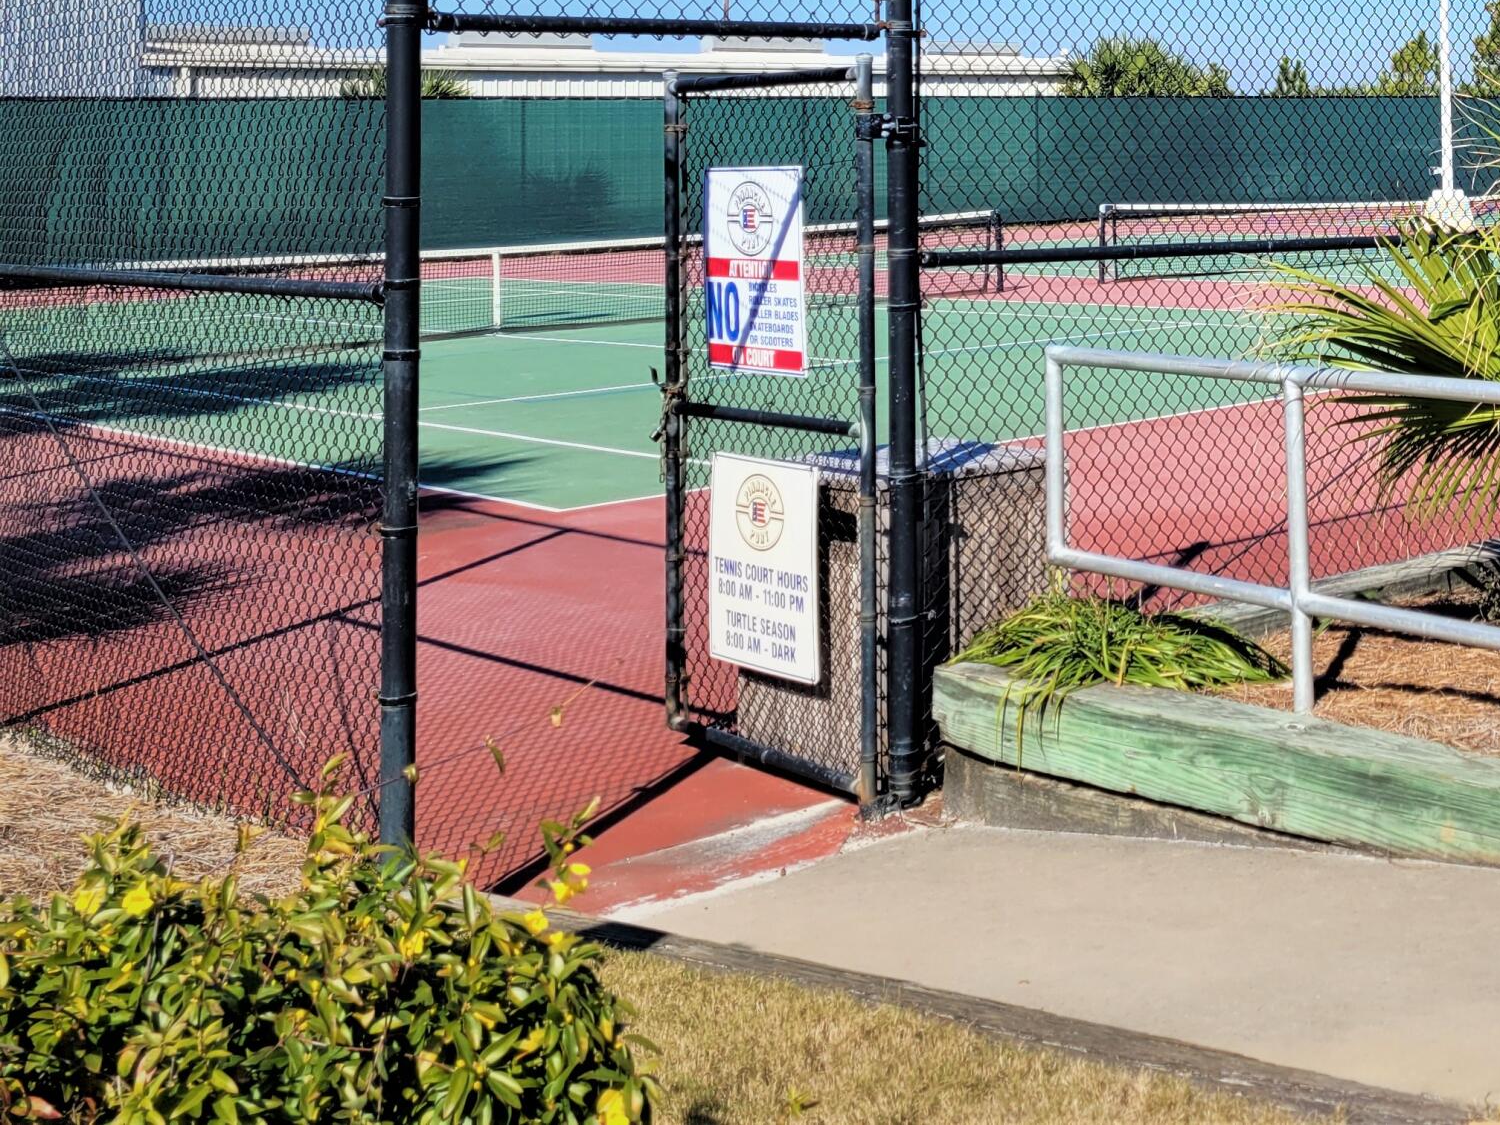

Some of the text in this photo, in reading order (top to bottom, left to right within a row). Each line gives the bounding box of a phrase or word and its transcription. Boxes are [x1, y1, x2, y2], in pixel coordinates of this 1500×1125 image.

[729, 259, 775, 279] ATTENTION
[707, 281, 740, 342] NO
[774, 297, 798, 308] SKATES
[749, 320, 795, 334] SKATEBOARDS
[774, 311, 799, 321] BLADES
[749, 334, 794, 348] OR SCOOTERS
[732, 346, 776, 368] ON COURT
[714, 556, 808, 593] TENNIS COURT HOURS
[718, 578, 736, 597] 8:00
[739, 583, 752, 601] AM
[763, 588, 786, 609] 11:00
[789, 594, 804, 614] PM
[726, 609, 796, 642] TURTLE SEASON
[726, 630, 744, 650] 8:00
[747, 636, 760, 654] AM
[771, 642, 796, 663] DARK
